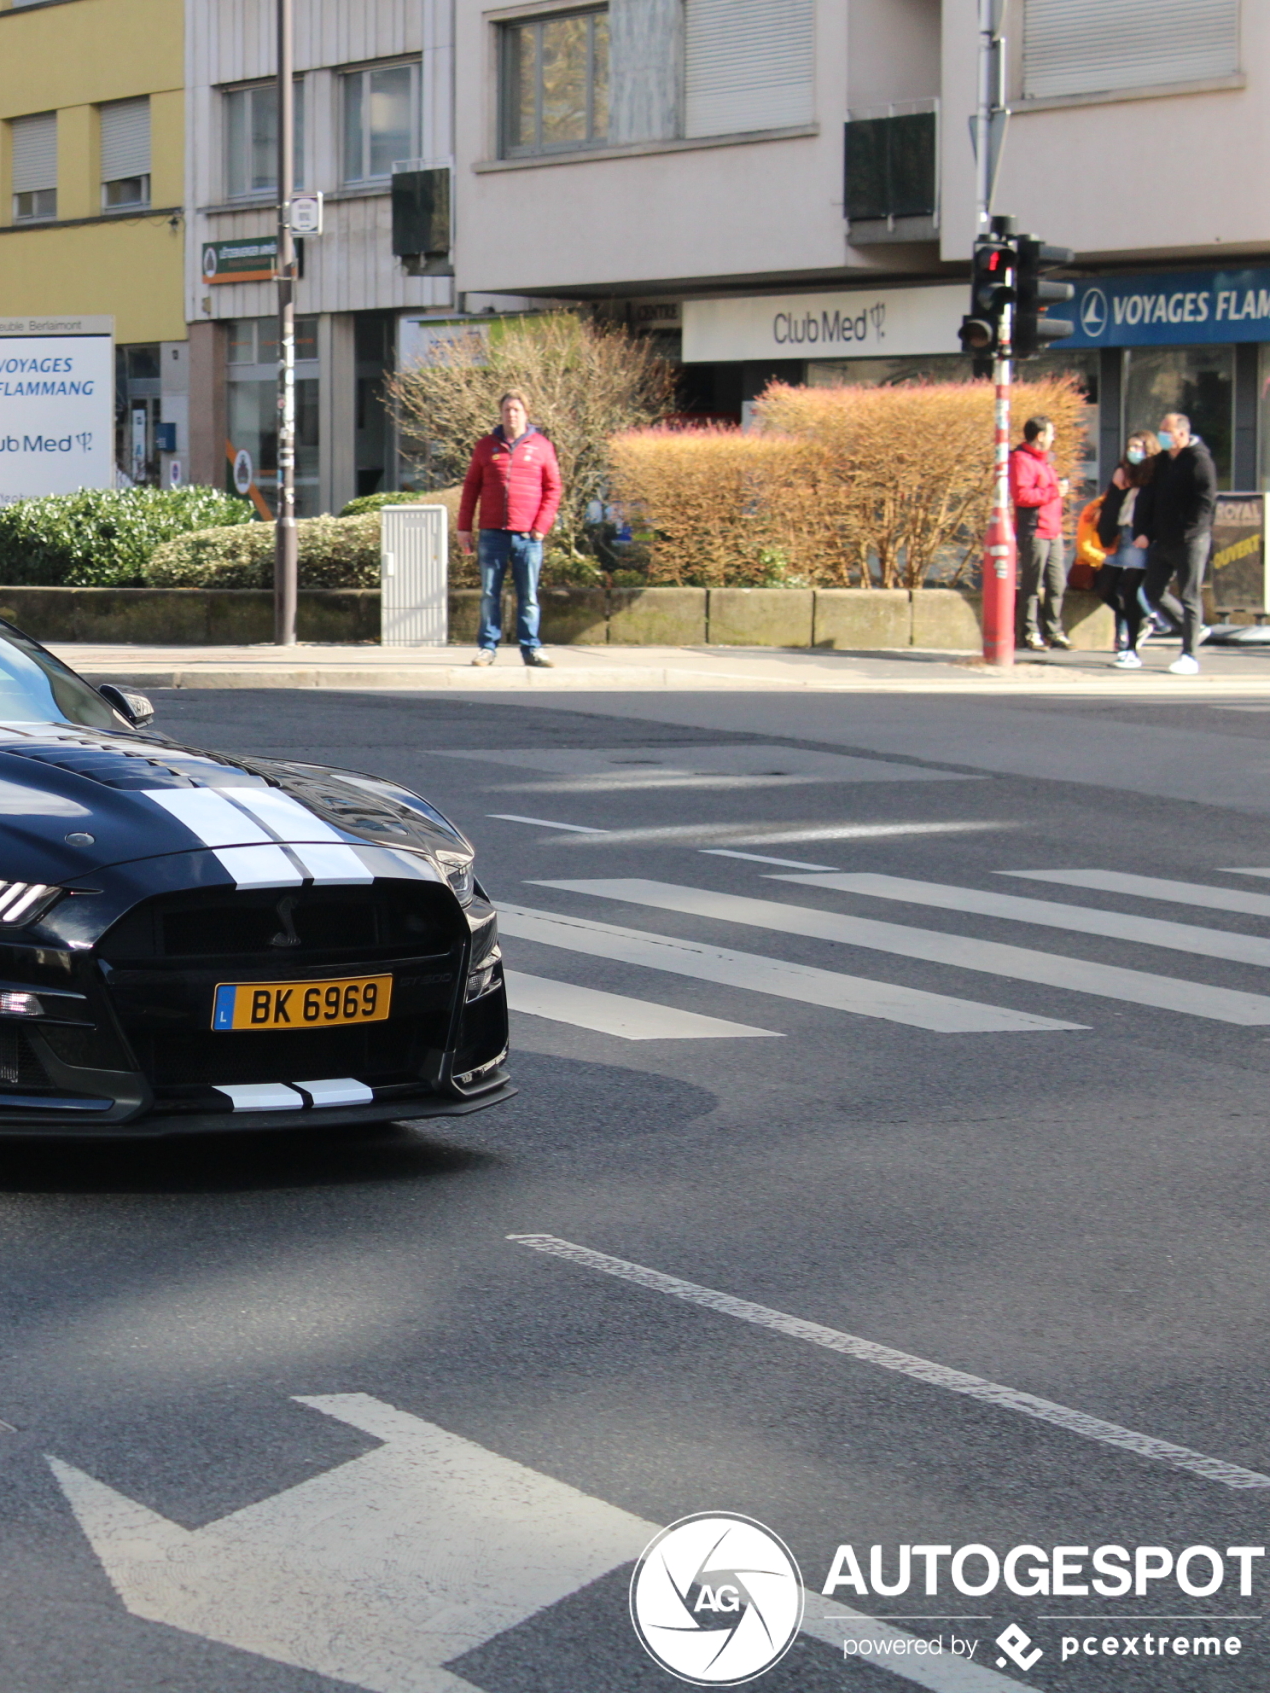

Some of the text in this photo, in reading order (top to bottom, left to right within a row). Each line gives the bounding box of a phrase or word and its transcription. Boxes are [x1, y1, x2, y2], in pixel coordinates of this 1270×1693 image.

[29, 320, 82, 331] Berlaimont
[1113, 292, 1210, 325] VOYAGES
[773, 308, 867, 344] Club Med
[23, 435, 72, 452] Med
[1213, 533, 1262, 569] OUVERT
[219, 982, 378, 1024] L BK 6969
